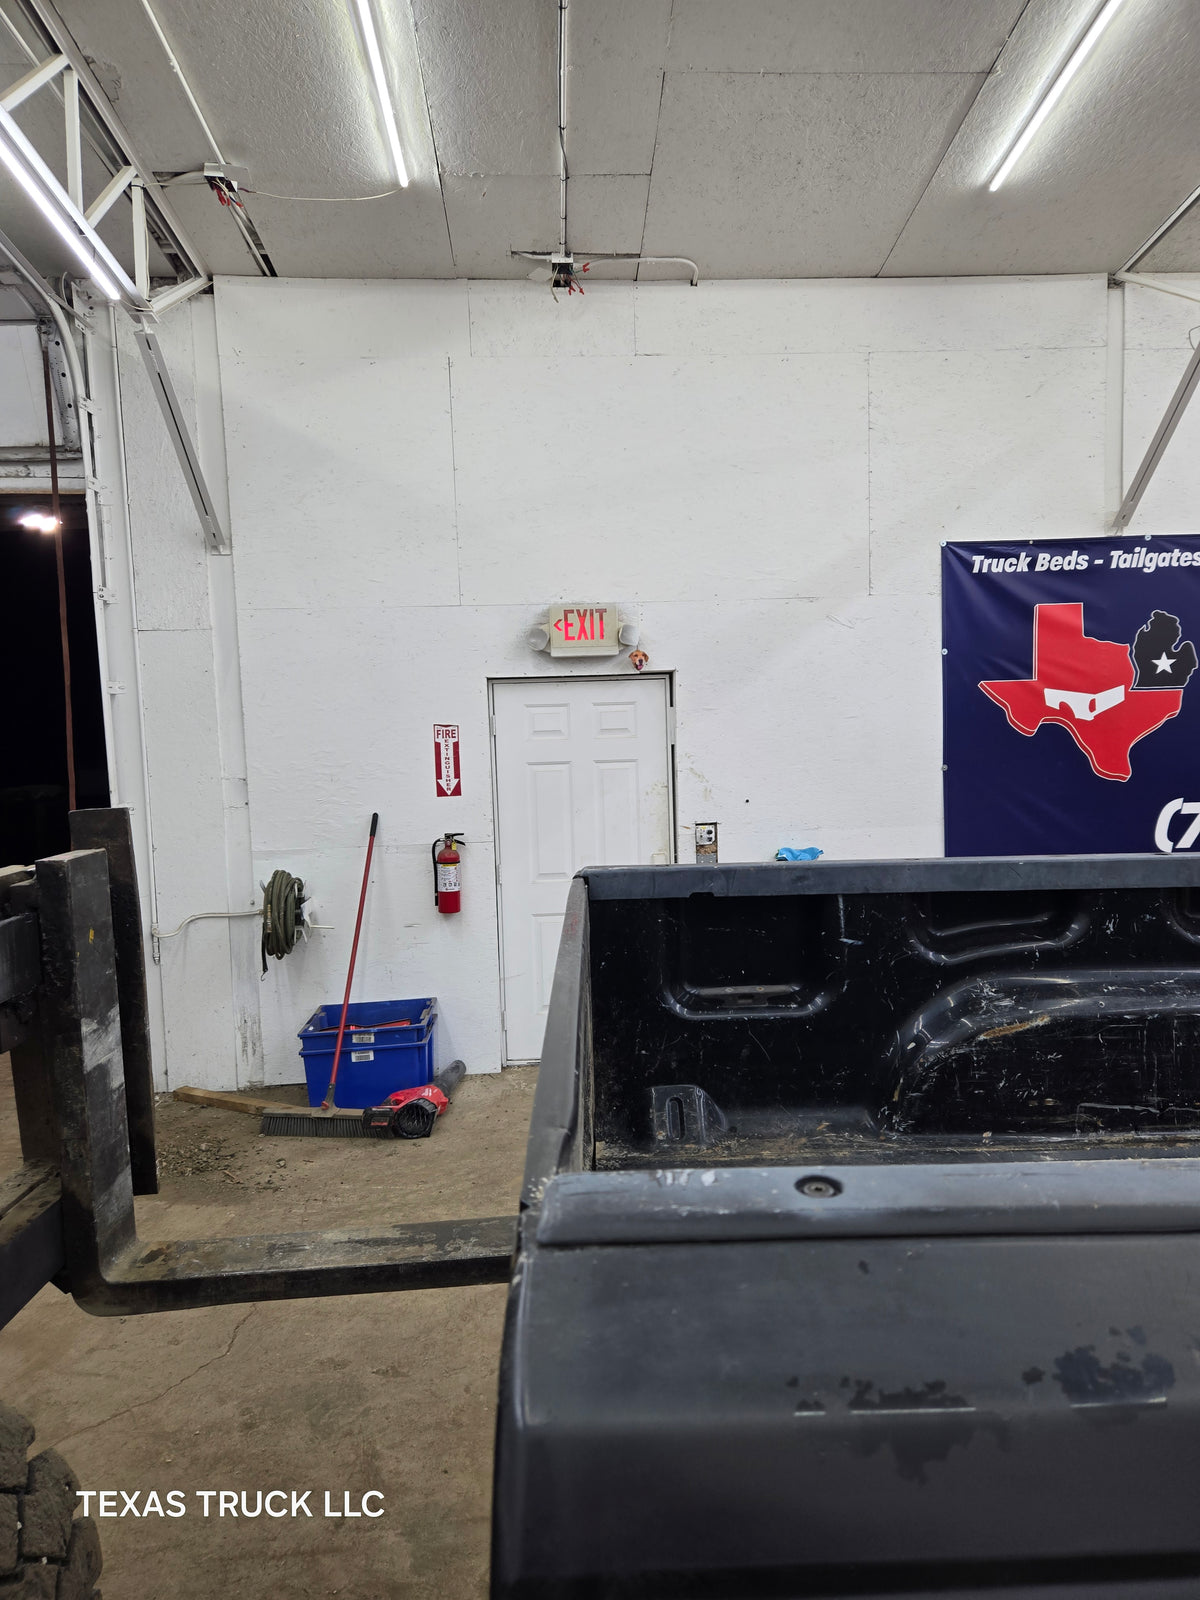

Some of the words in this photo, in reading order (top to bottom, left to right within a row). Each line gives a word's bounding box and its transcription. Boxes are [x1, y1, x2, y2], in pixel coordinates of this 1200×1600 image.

[972, 552, 1030, 573] Truck
[1034, 551, 1089, 572] Beds
[1109, 547, 1200, 573] Tailgates
[563, 608, 607, 641] EXIT
[436, 729, 457, 739] FIRE
[444, 739, 452, 792] EXTINGUISHER
